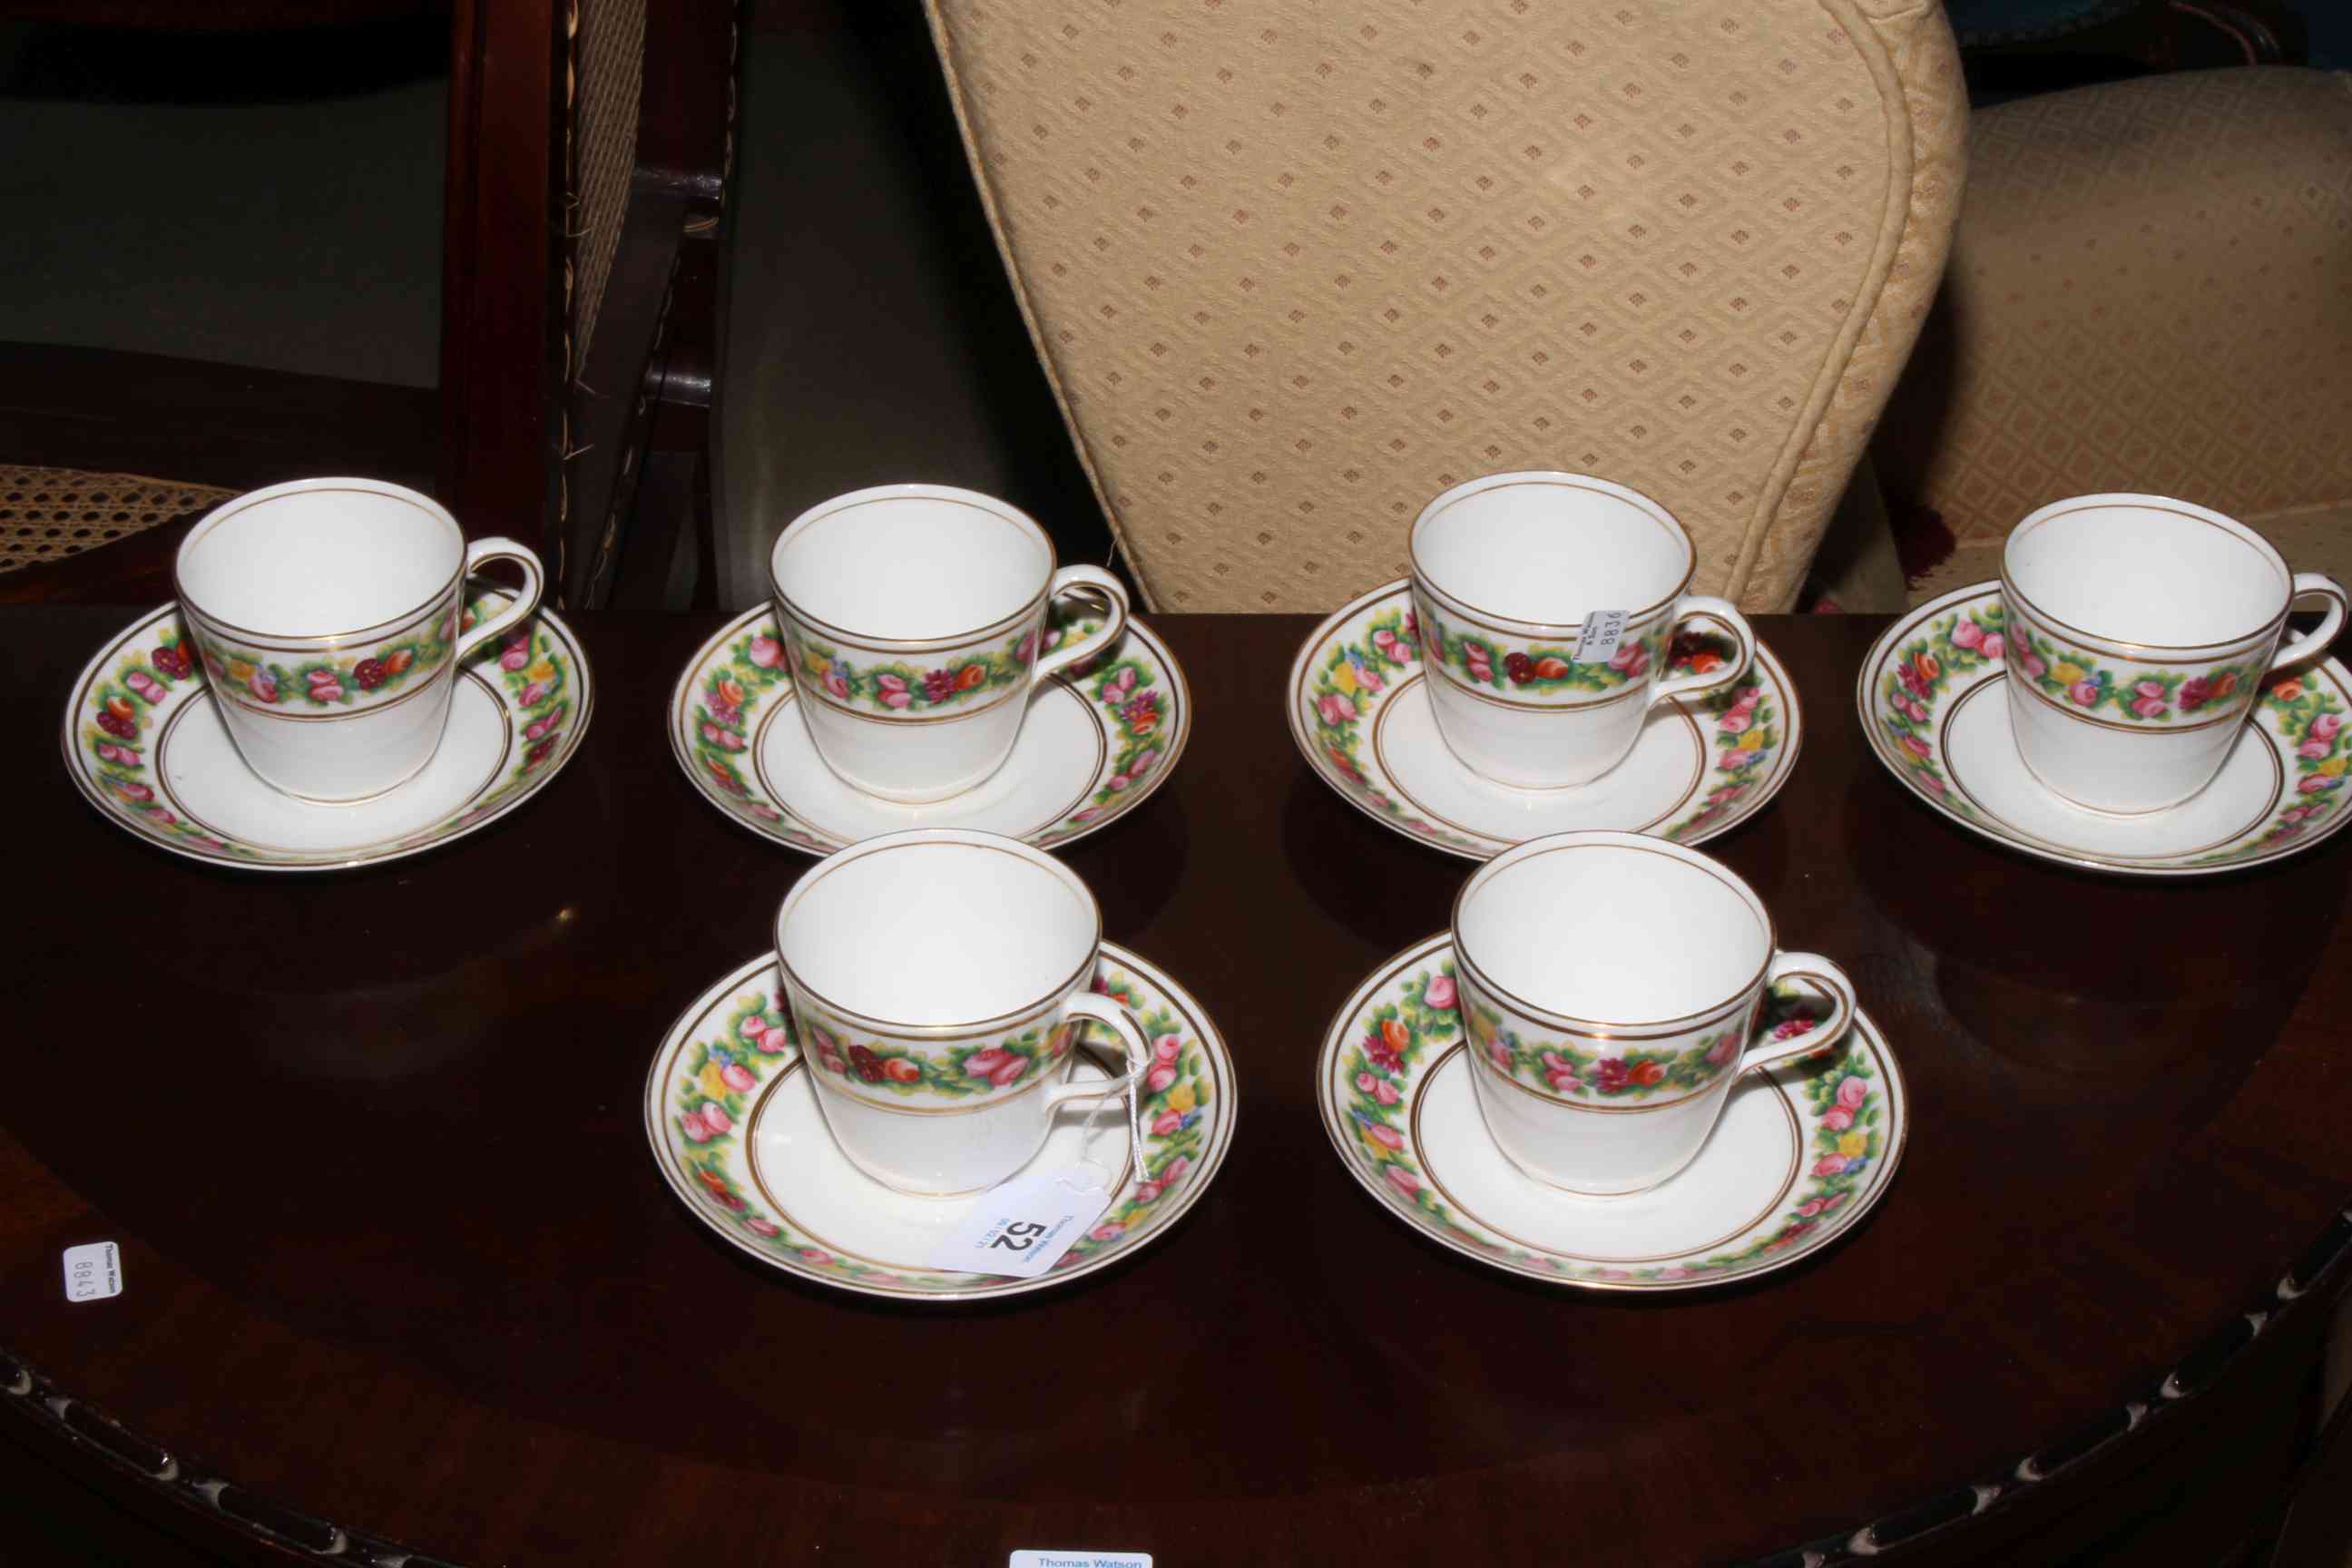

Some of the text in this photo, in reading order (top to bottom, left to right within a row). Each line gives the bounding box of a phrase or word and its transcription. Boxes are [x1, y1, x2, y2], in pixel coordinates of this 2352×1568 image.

[1600, 612, 1622, 645] 8836
[991, 1221, 1047, 1250] 52
[74, 1261, 95, 1297] 8843
[1038, 1558, 1142, 1568] Thomas Watson
